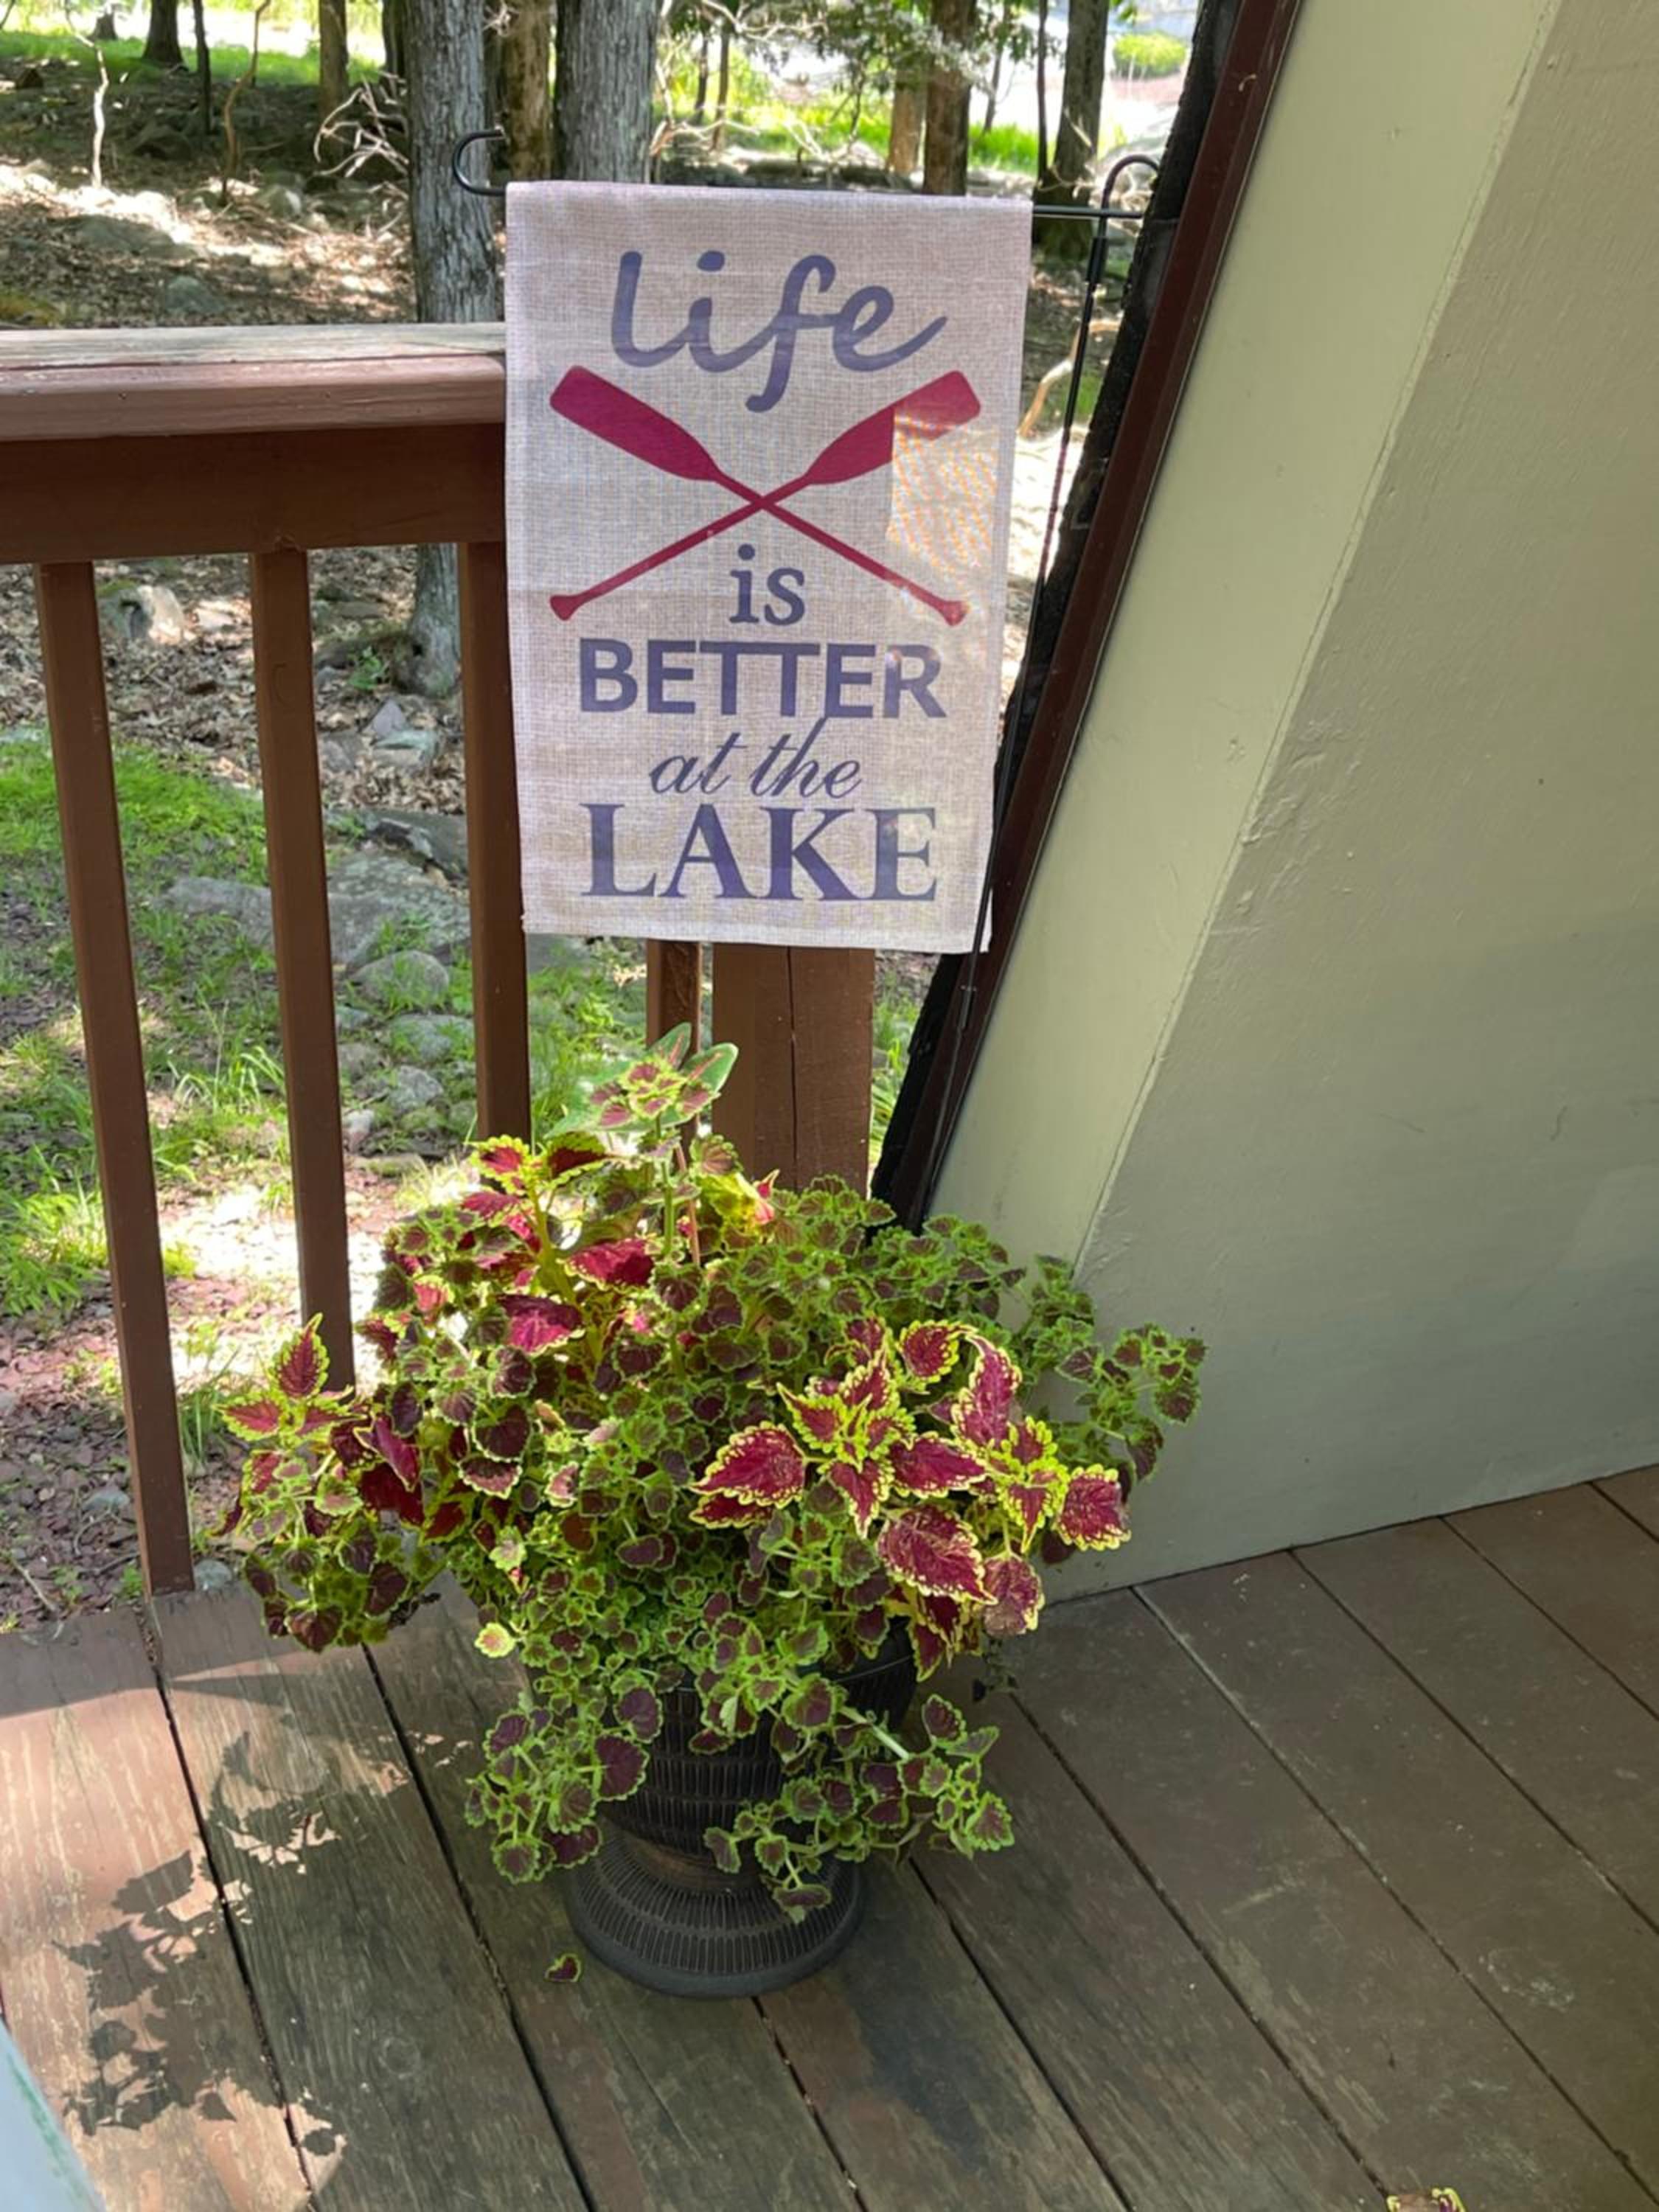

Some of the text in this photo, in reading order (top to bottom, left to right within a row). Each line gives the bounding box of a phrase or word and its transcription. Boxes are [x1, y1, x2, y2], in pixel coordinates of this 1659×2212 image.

[611, 250, 948, 412] life
[729, 543, 806, 625] is
[580, 638, 947, 719] BETTER
[649, 717, 863, 799] at the
[581, 804, 936, 901] LAKE
